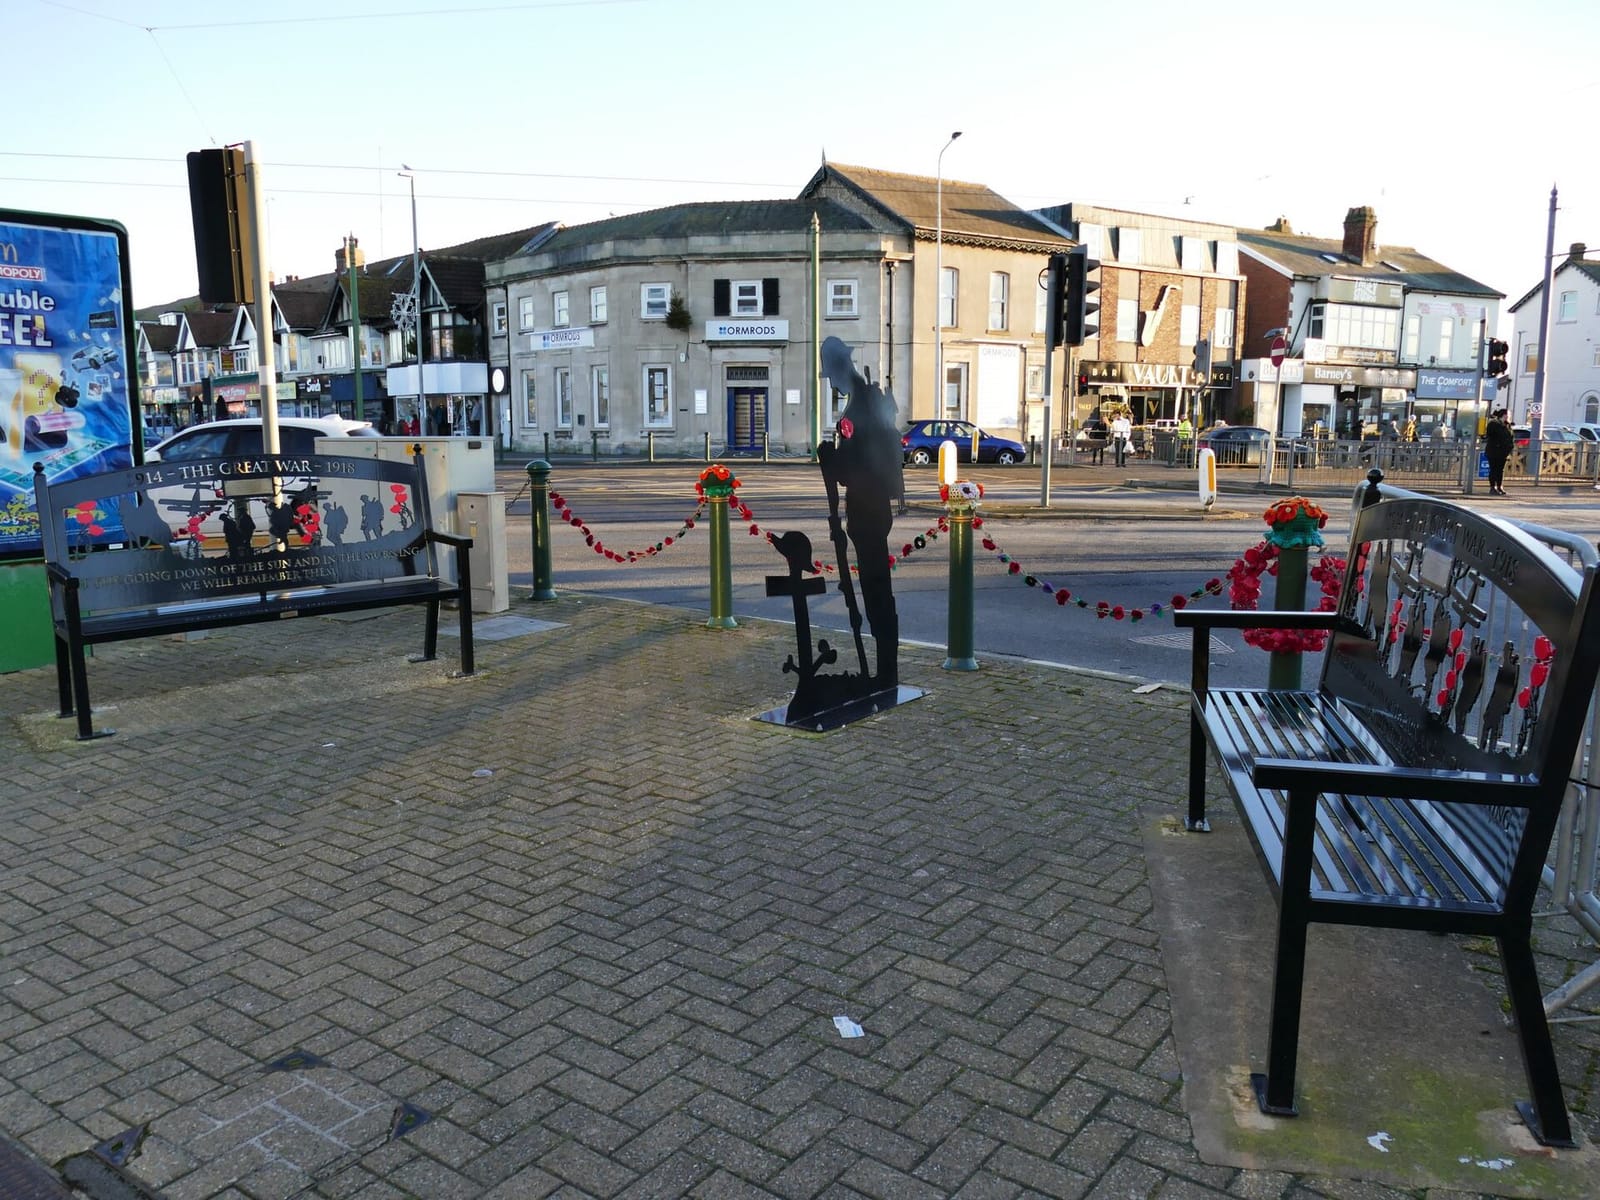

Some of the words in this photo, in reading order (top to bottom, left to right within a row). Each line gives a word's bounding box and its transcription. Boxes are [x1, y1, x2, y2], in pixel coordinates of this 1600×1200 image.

[0, 267, 41, 279] OPOLY
[550, 331, 581, 344] ORMRODS
[727, 326, 776, 336] ORMRODS
[1092, 367, 1118, 377] BAR
[1131, 363, 1192, 386] VAULT
[1191, 371, 1231, 381] LONGE
[1315, 367, 1352, 382] Barney's
[1421, 376, 1437, 385] THE
[1437, 376, 1473, 387] COMFORT
[179, 463, 215, 481] THE
[219, 460, 271, 476] GREAT
[274, 459, 313, 474] WAR
[326, 460, 355, 475] 1918
[125, 570, 172, 586] GOING
[175, 566, 217, 580] DOWN
[219, 562, 237, 575] OF
[241, 560, 265, 574] THE
[267, 557, 292, 572] SUN
[294, 556, 321, 569] AND
[180, 580, 201, 593] WE
[203, 575, 234, 590] WILL
[236, 570, 303, 586] REMEMBER
